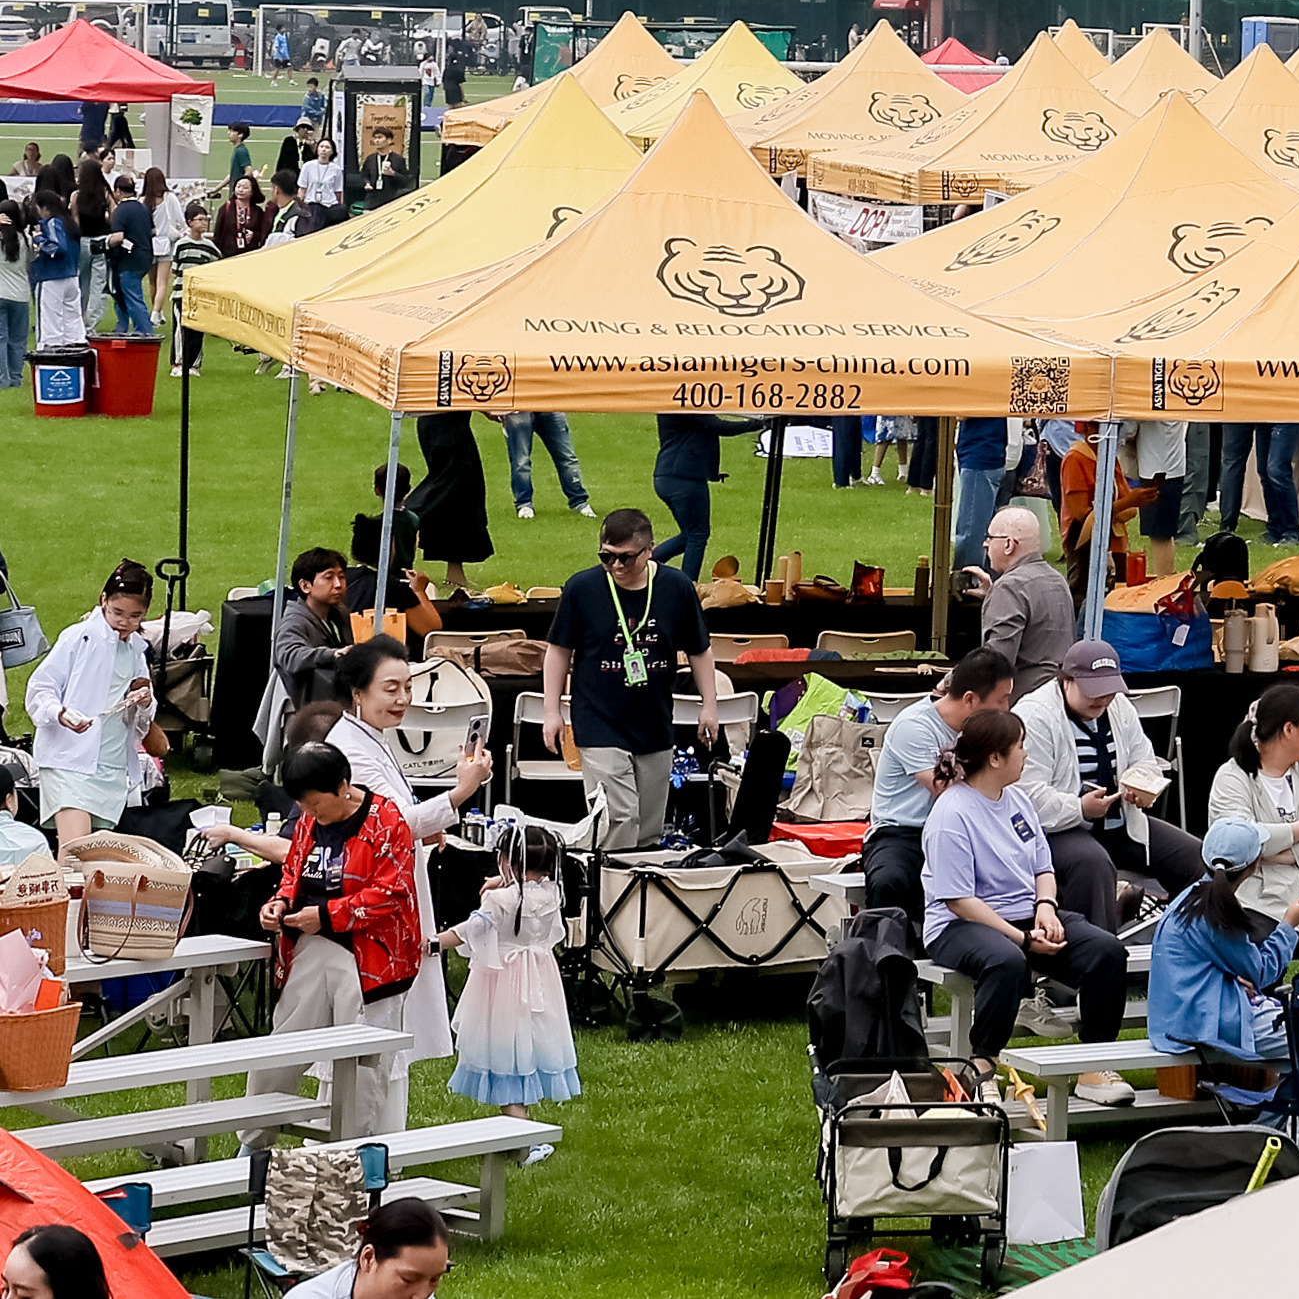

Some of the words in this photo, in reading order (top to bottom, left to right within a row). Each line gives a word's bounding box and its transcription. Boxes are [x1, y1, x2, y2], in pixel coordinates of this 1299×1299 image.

[848, 208, 886, 238] DCP
[524, 317, 641, 335] MOVING
[650, 321, 668, 335] &
[675, 322, 846, 337] RELOCATION
[852, 324, 970, 339] SERVICES
[549, 353, 970, 378] www.asiantigers-china.com
[672, 381, 863, 410] 400-168-2882
[1153, 383, 1164, 409] ASIAN
[402, 762, 422, 770] CATL
